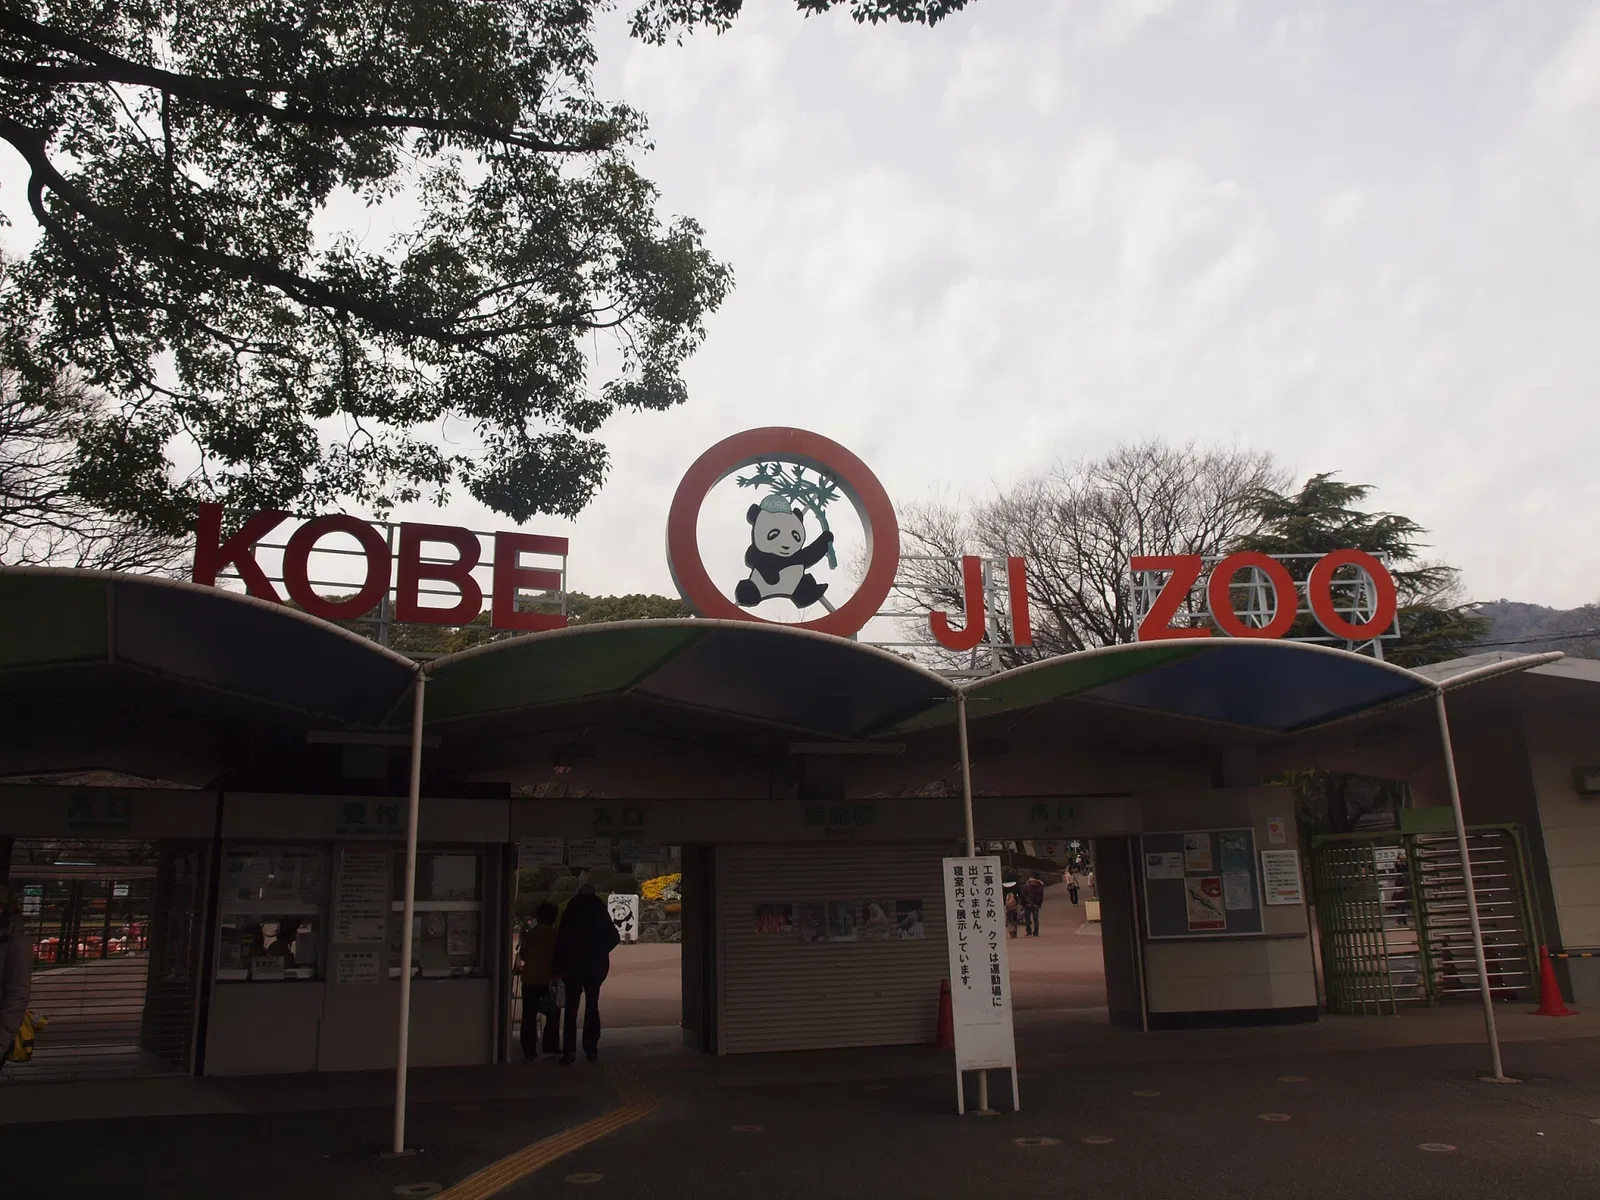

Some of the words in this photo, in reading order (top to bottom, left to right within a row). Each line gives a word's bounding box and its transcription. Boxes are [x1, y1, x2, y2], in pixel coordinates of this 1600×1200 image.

[764, 500, 788, 511] KOBE
[193, 502, 568, 632] KOBE
[1130, 548, 1400, 641] ZOO
[953, 866, 972, 990] 寝室内で展示しています。
[968, 865, 983, 934] 出ていません。
[983, 865, 1002, 1008] 工事のため、クマは運動場に
